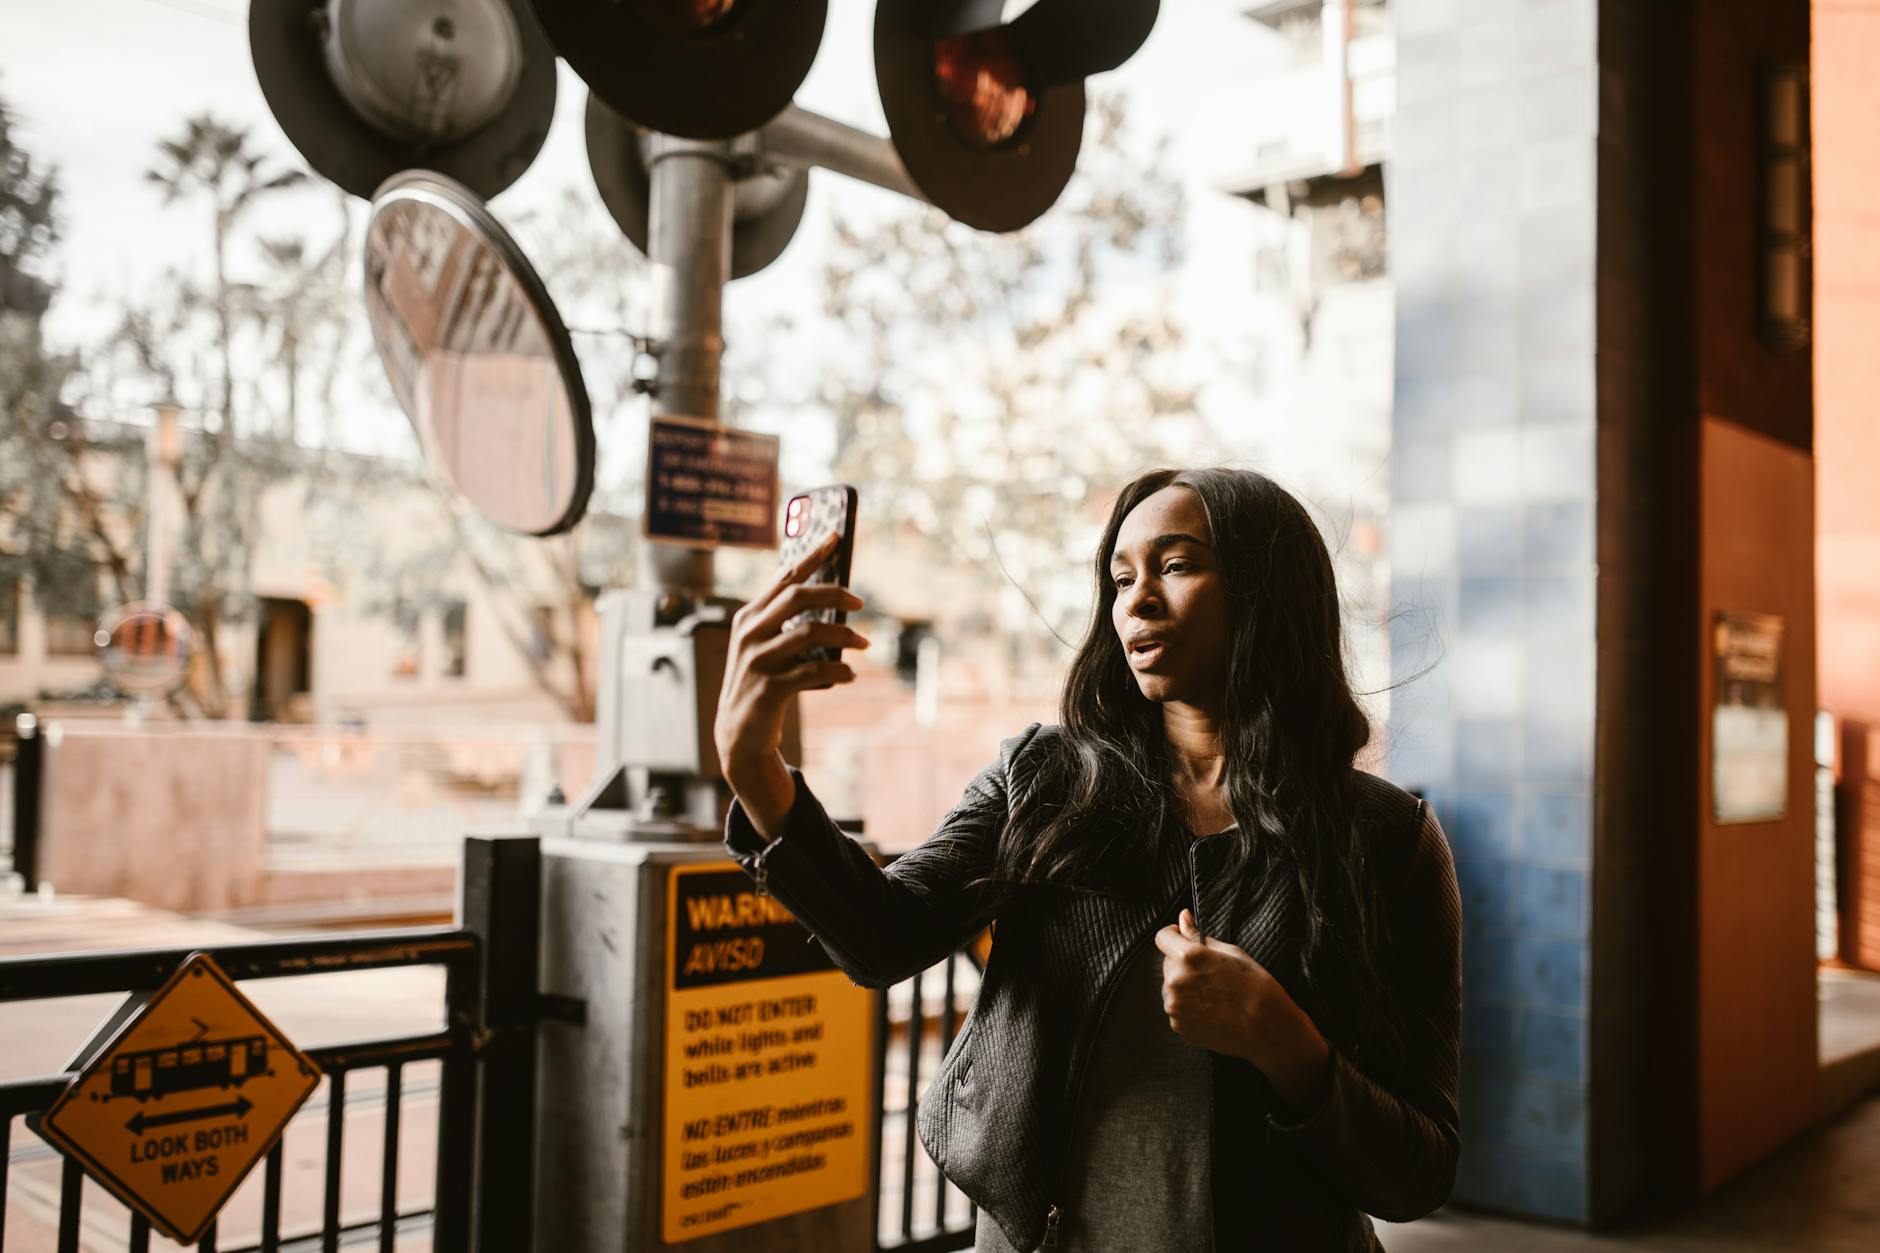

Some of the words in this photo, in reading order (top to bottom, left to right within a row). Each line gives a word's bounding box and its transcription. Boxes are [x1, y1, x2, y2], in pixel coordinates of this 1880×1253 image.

[687, 892, 796, 931] WARN
[683, 937, 765, 975] AVISO
[685, 1009, 713, 1033] DO
[716, 1002, 753, 1027] NOT
[757, 994, 817, 1022] ENTER
[684, 1035, 733, 1058] while
[738, 1028, 787, 1056] lights
[792, 1022, 824, 1042] and
[684, 1063, 729, 1088] bells
[735, 1060, 763, 1080] are
[768, 1052, 816, 1075] active
[682, 1119, 711, 1142] NO
[713, 1106, 771, 1138] ENTRE
[777, 1098, 846, 1122] mientras
[131, 1134, 190, 1162] LOOK
[194, 1125, 248, 1151] BOTH
[682, 1150, 710, 1171] las
[714, 1142, 757, 1165] luces
[771, 1122, 853, 1151] campanas
[161, 1156, 220, 1184] WAYS
